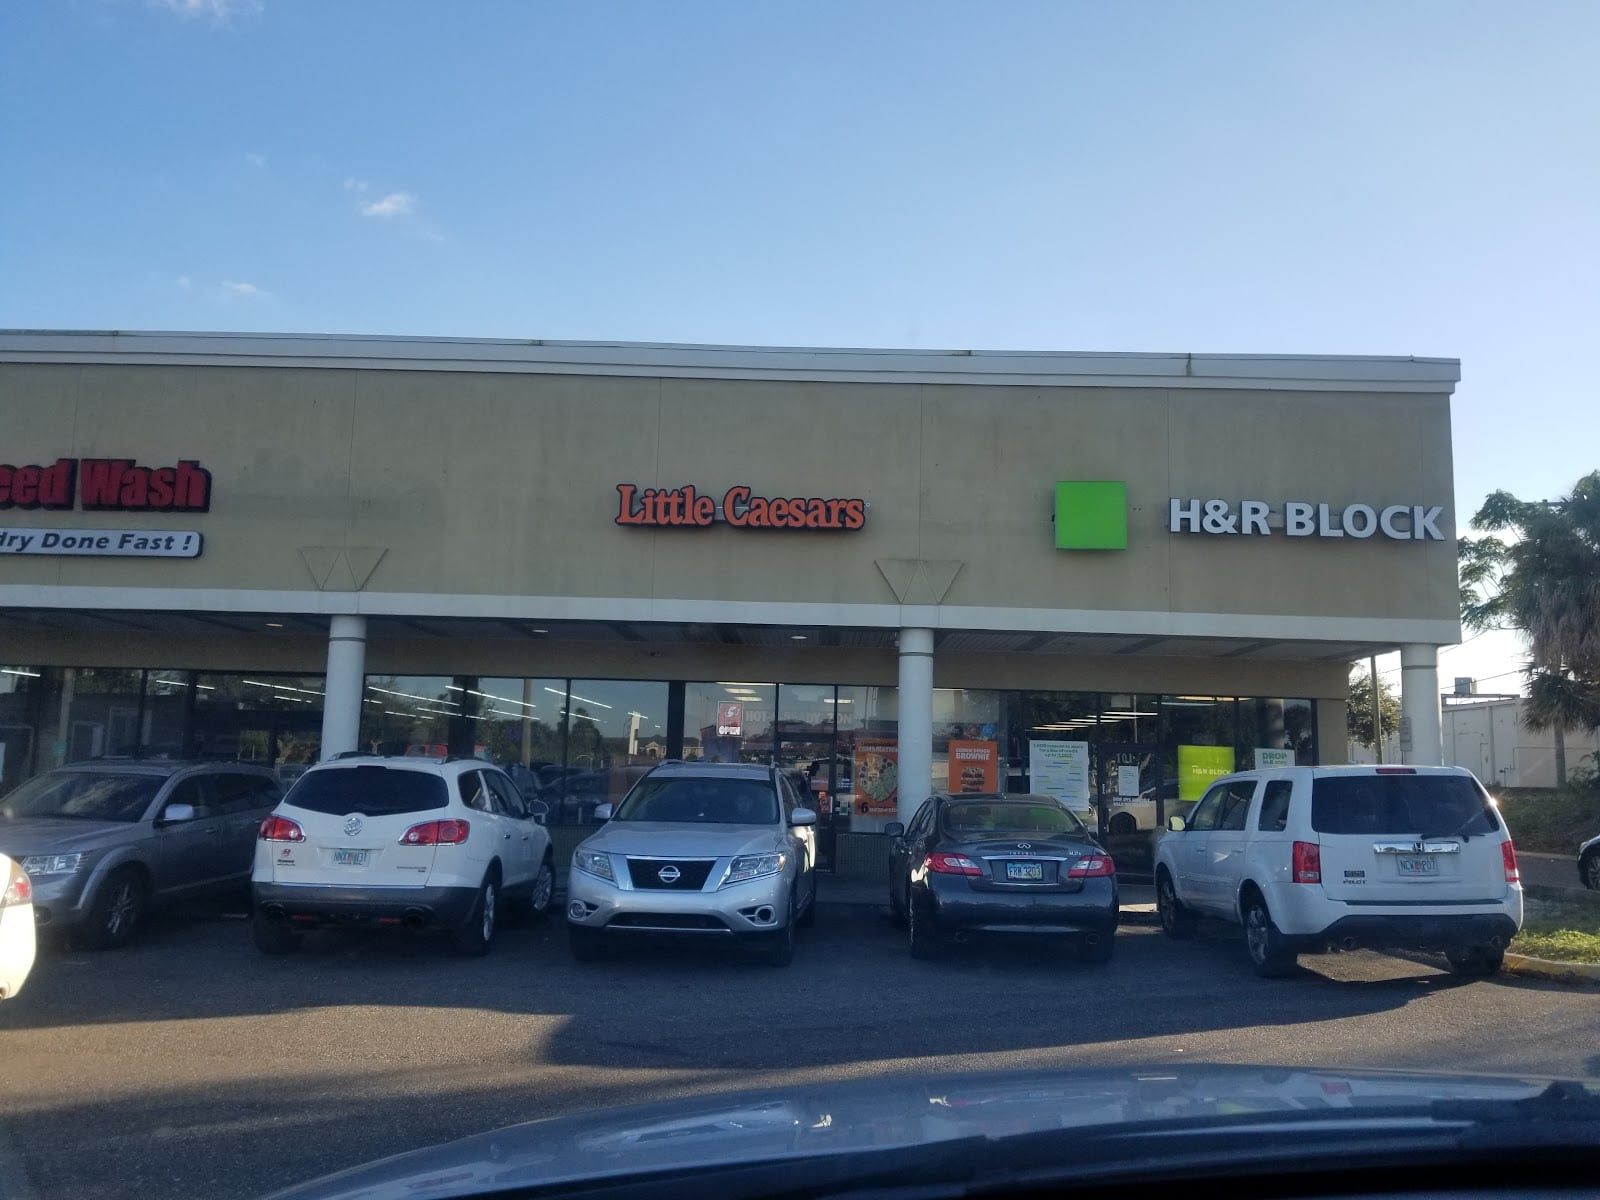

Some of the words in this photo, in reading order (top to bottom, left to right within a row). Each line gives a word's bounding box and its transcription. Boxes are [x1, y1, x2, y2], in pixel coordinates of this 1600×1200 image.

[81, 459, 211, 512] Wash
[615, 484, 715, 527] Little
[722, 485, 866, 531] Caesars
[1169, 498, 1272, 536] H&R
[1285, 502, 1444, 541] BLOCK
[41, 533, 110, 549] Done
[118, 534, 175, 550] Fast
[718, 726, 740, 735] OPEN
[955, 752, 990, 760] BROWNIE
[1209, 768, 1231, 776] BLOCK
